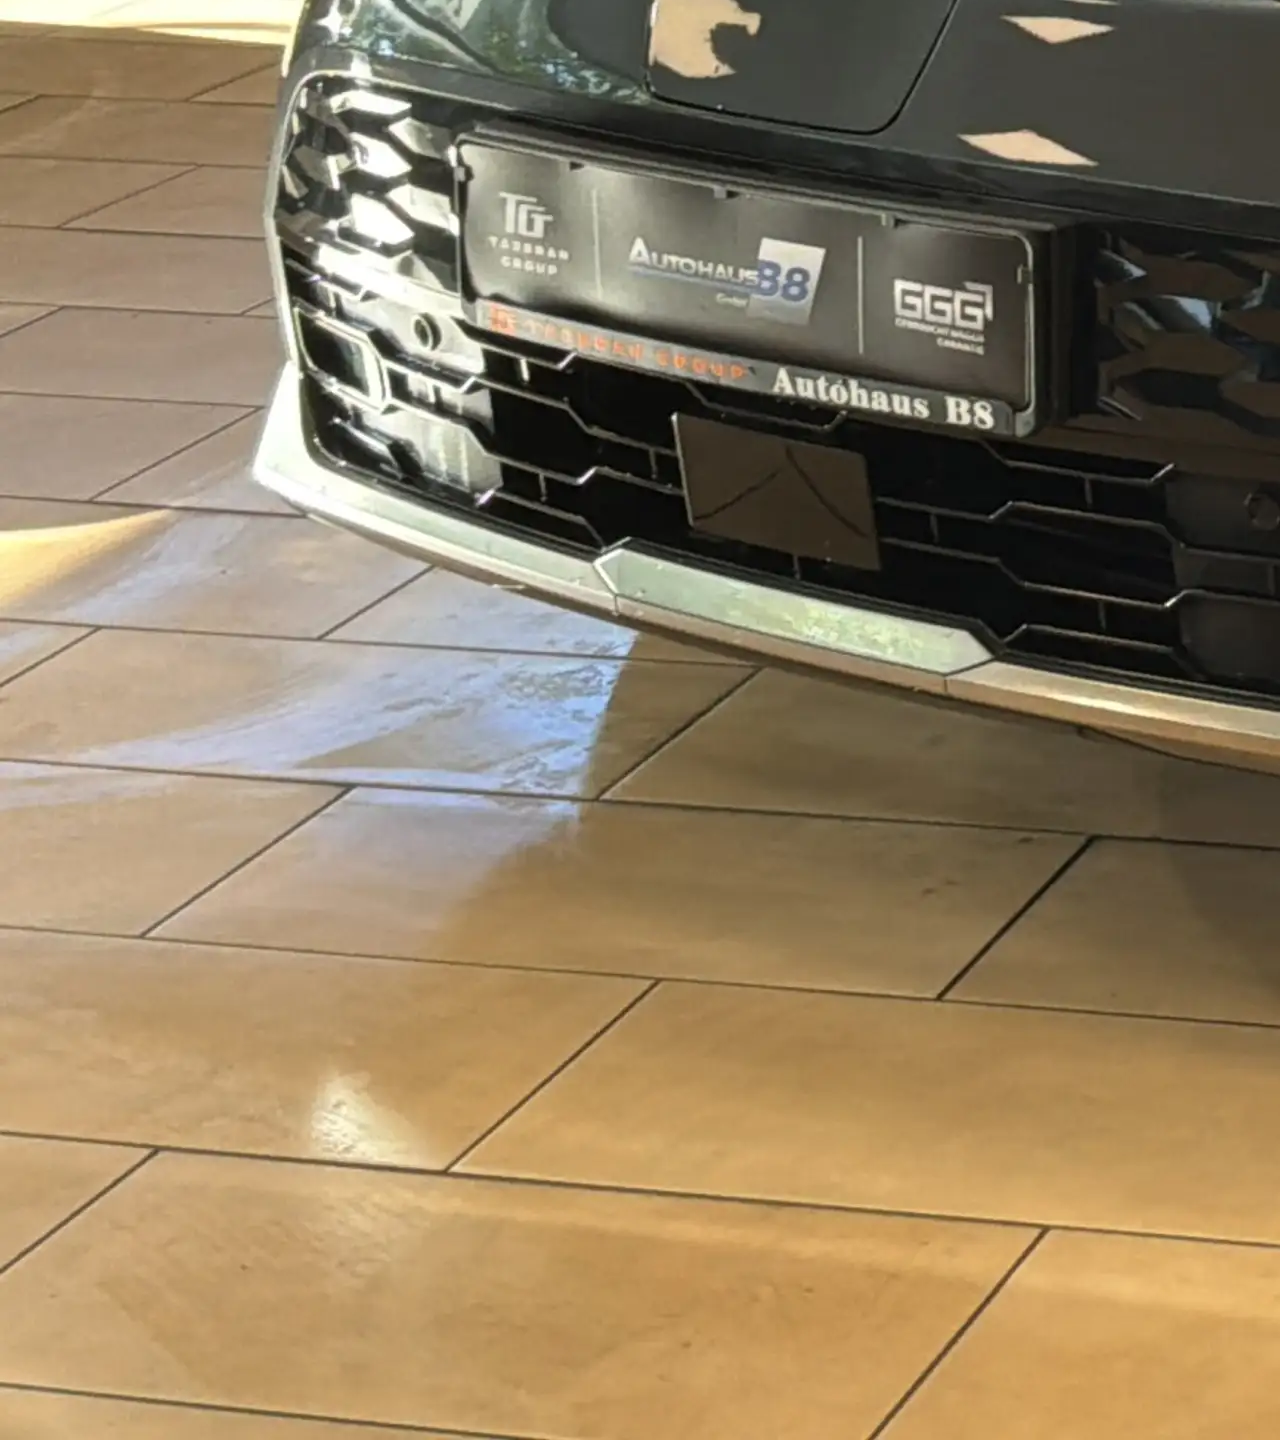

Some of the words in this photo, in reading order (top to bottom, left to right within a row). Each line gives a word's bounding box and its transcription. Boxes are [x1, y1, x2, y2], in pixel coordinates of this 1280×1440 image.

[893, 278, 993, 331] GGG
[772, 367, 930, 419] Autohaus
[944, 395, 996, 430] B8
